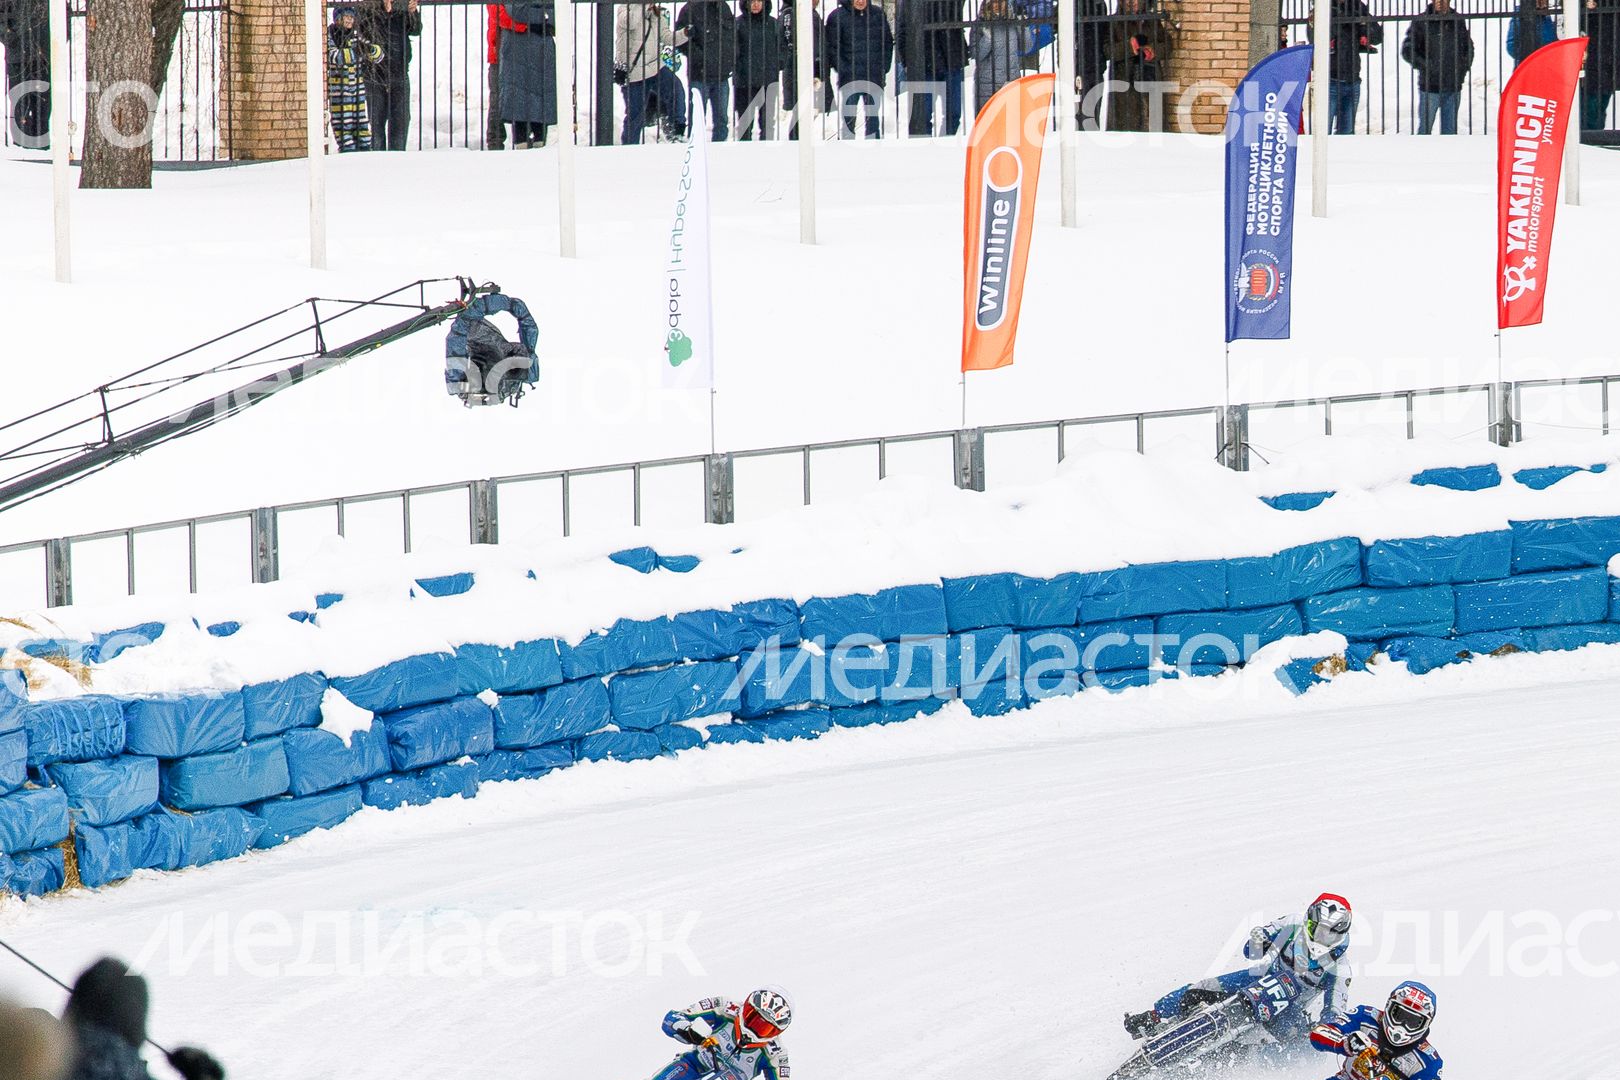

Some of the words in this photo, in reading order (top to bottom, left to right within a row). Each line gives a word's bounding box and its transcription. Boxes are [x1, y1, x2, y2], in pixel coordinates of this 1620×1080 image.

[1273, 110, 1289, 174] РОССИИ
[1541, 99, 1558, 145] yms.ru
[1245, 142, 1261, 236] ФЕДЕРАЦИЯ
[1256, 92, 1278, 236] МОТОЦИКЛЕТНОГО
[1506, 94, 1547, 254] YAKHNICH
[1269, 177, 1285, 237] СПОРТА
[1527, 176, 1545, 253] motorsport
[978, 198, 1011, 314] winline
[1257, 974, 1290, 1017] UFA
